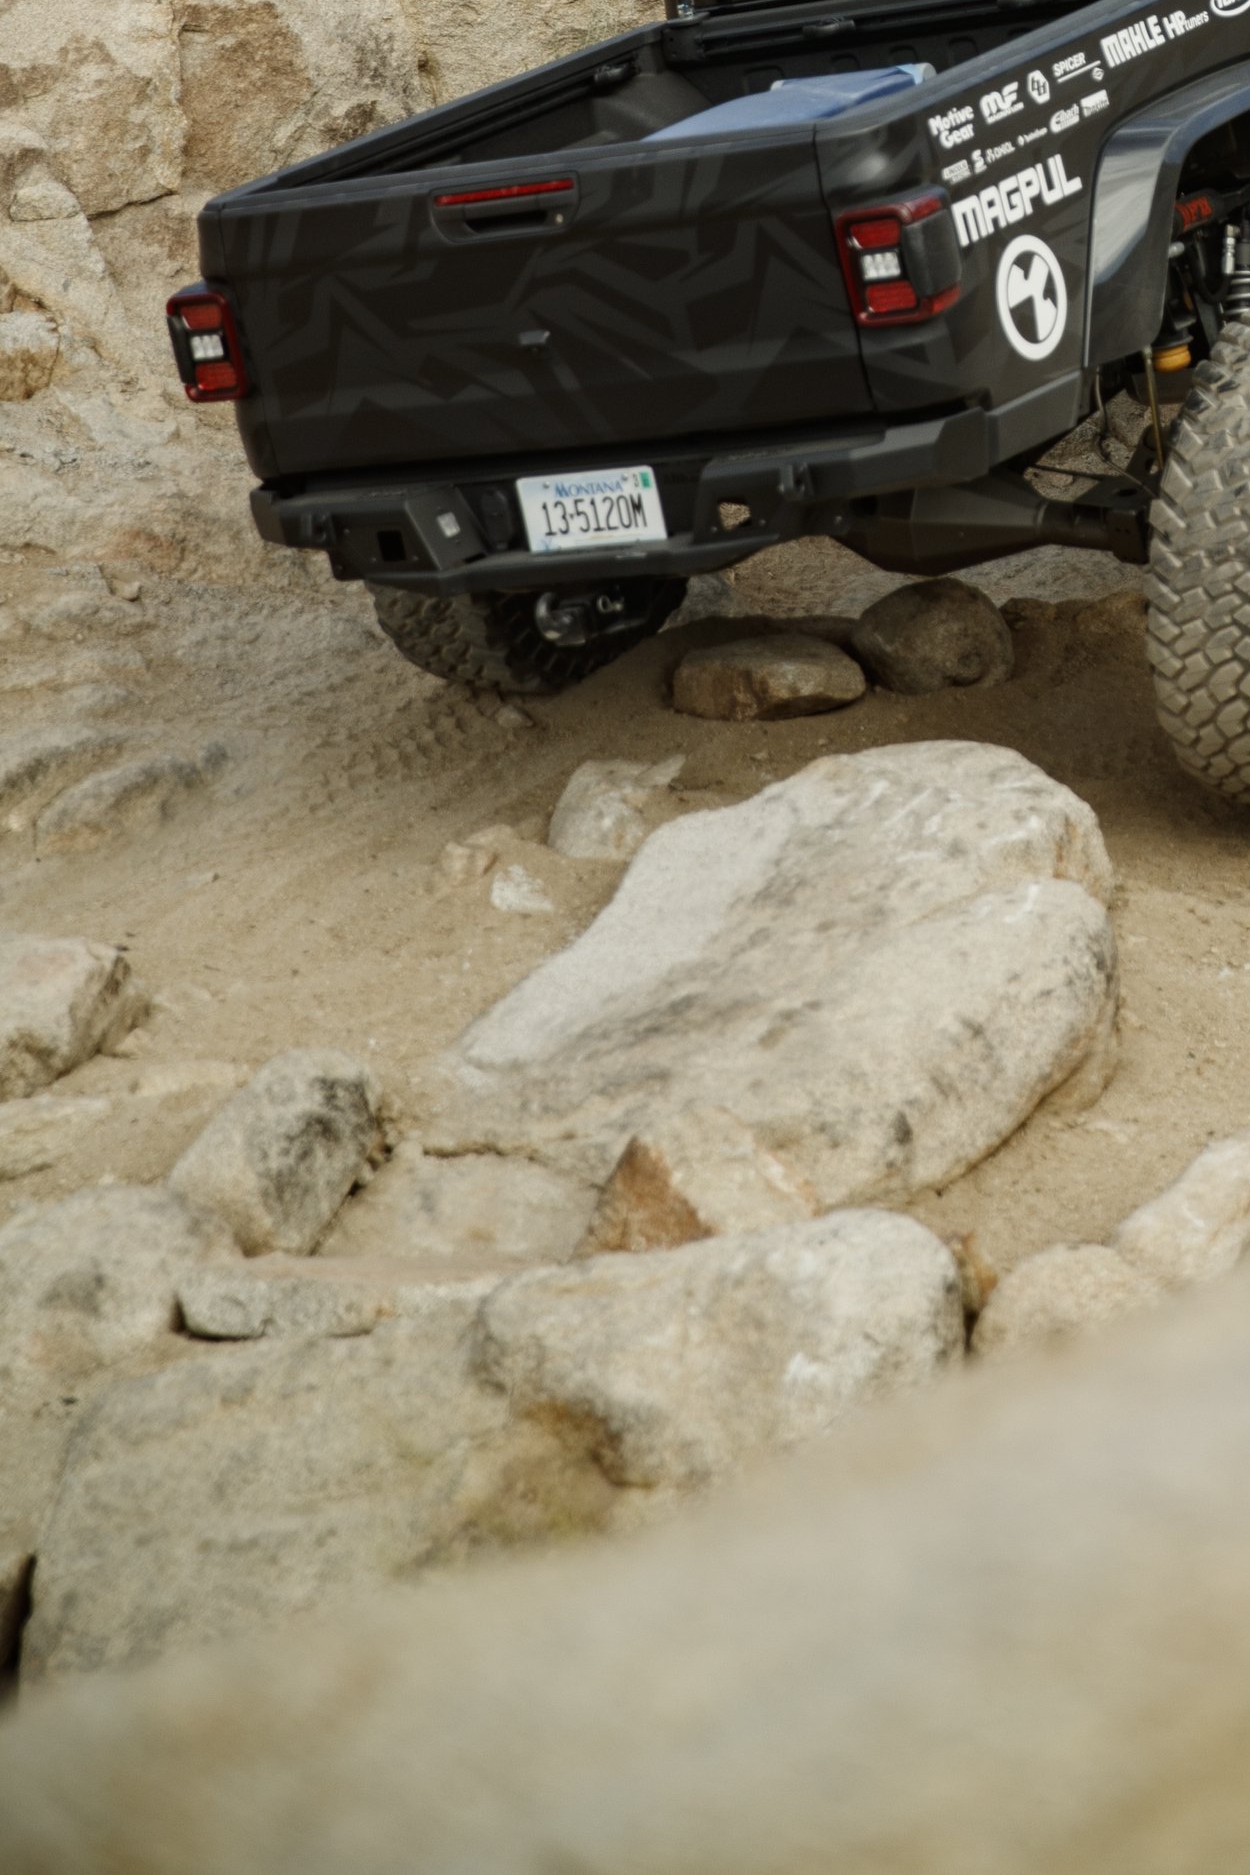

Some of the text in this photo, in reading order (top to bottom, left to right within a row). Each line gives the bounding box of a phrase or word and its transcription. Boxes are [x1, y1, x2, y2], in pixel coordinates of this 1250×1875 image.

[1100, 14, 1166, 68] MAHLE
[1052, 51, 1086, 78] SPICER
[927, 105, 975, 136] Motive
[940, 123, 975, 149] Gear
[951, 153, 1083, 247] MAGPUL
